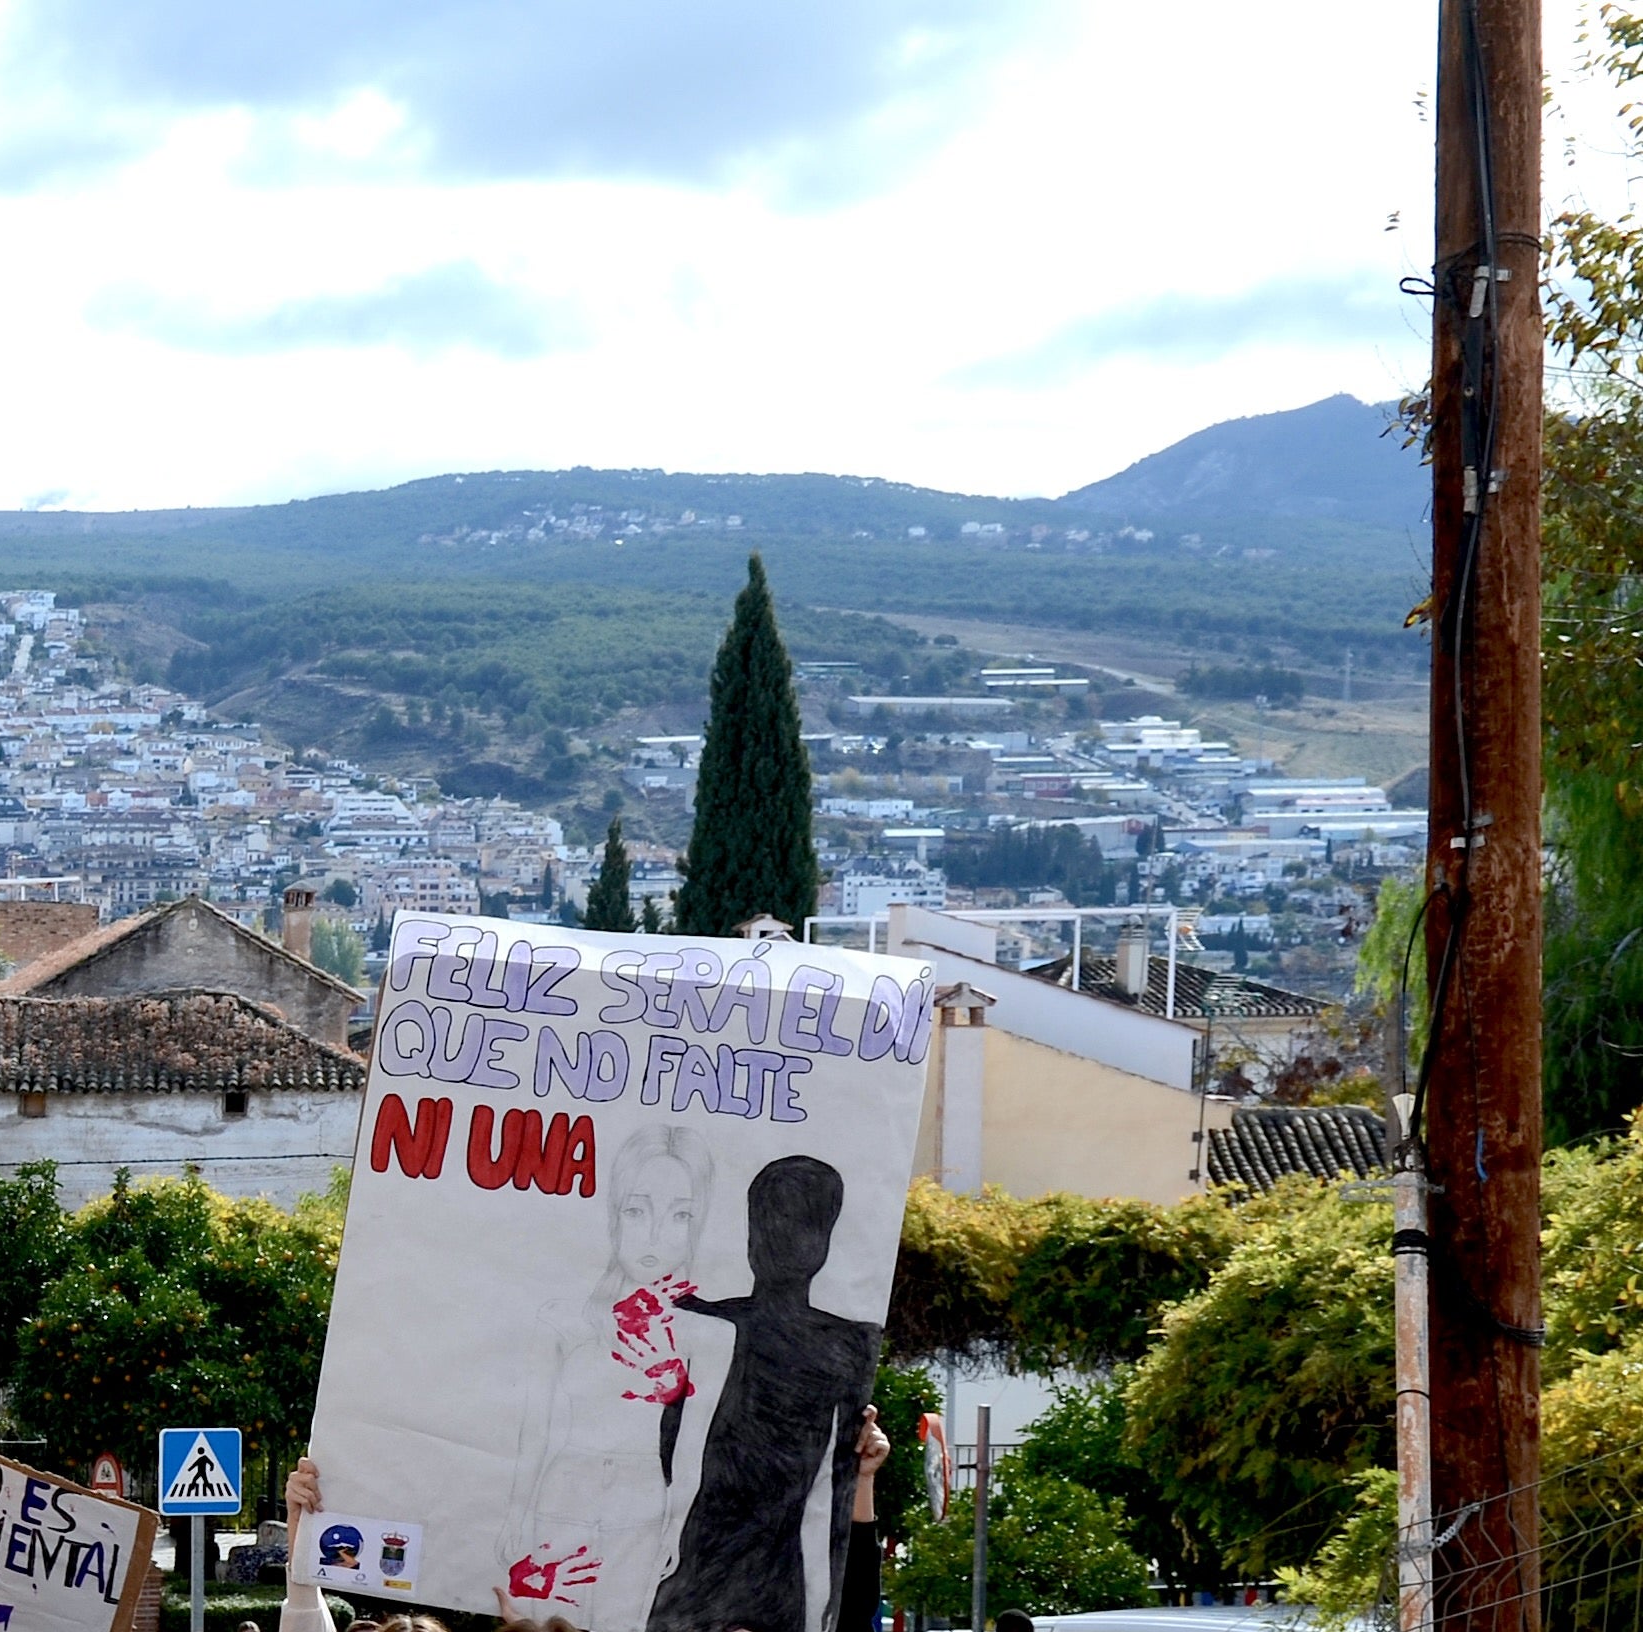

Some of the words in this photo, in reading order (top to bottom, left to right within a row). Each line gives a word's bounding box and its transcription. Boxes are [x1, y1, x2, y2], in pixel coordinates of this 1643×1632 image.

[392, 920, 580, 1015] FELIZ
[599, 941, 772, 1044] SERÁ
[779, 964, 853, 1058] EL
[379, 1001, 528, 1090] QUE
[534, 1026, 630, 1102] NO
[640, 1035, 813, 1122] FALTE
[370, 1094, 454, 1180] NI
[467, 1105, 597, 1198] UNA
[21, 1477, 83, 1534] ES
